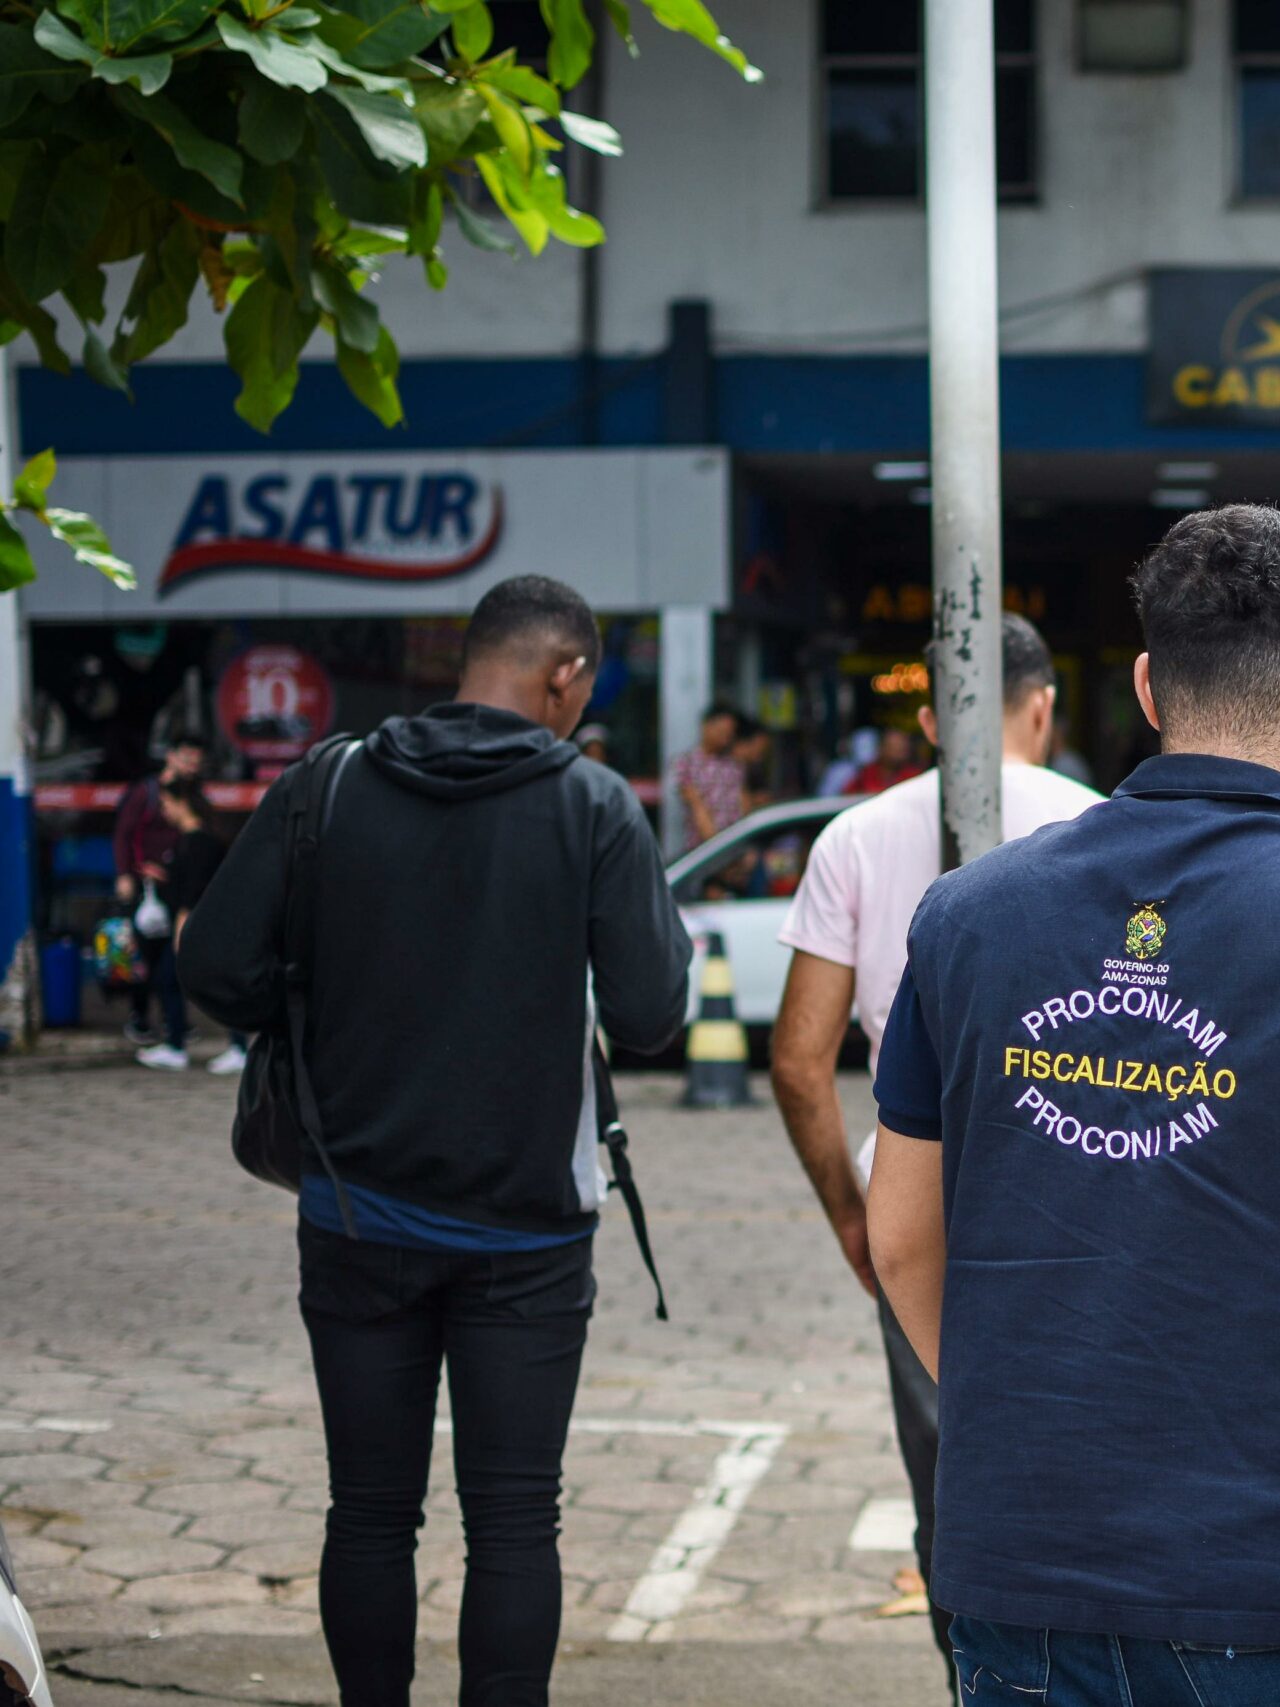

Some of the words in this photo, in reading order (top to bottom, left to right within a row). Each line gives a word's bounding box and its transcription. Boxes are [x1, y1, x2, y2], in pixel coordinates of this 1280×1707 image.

[172, 472, 480, 553] ASATUR
[1101, 970, 1167, 986] AMAZONAS
[1103, 958, 1153, 973] GOVERNO
[1157, 964, 1170, 974] DO
[1021, 985, 1228, 1058] PROCON/AM
[1004, 1047, 1237, 1101] FISCALIZAÇÃO
[1014, 1085, 1219, 1160] PROCON/AM
